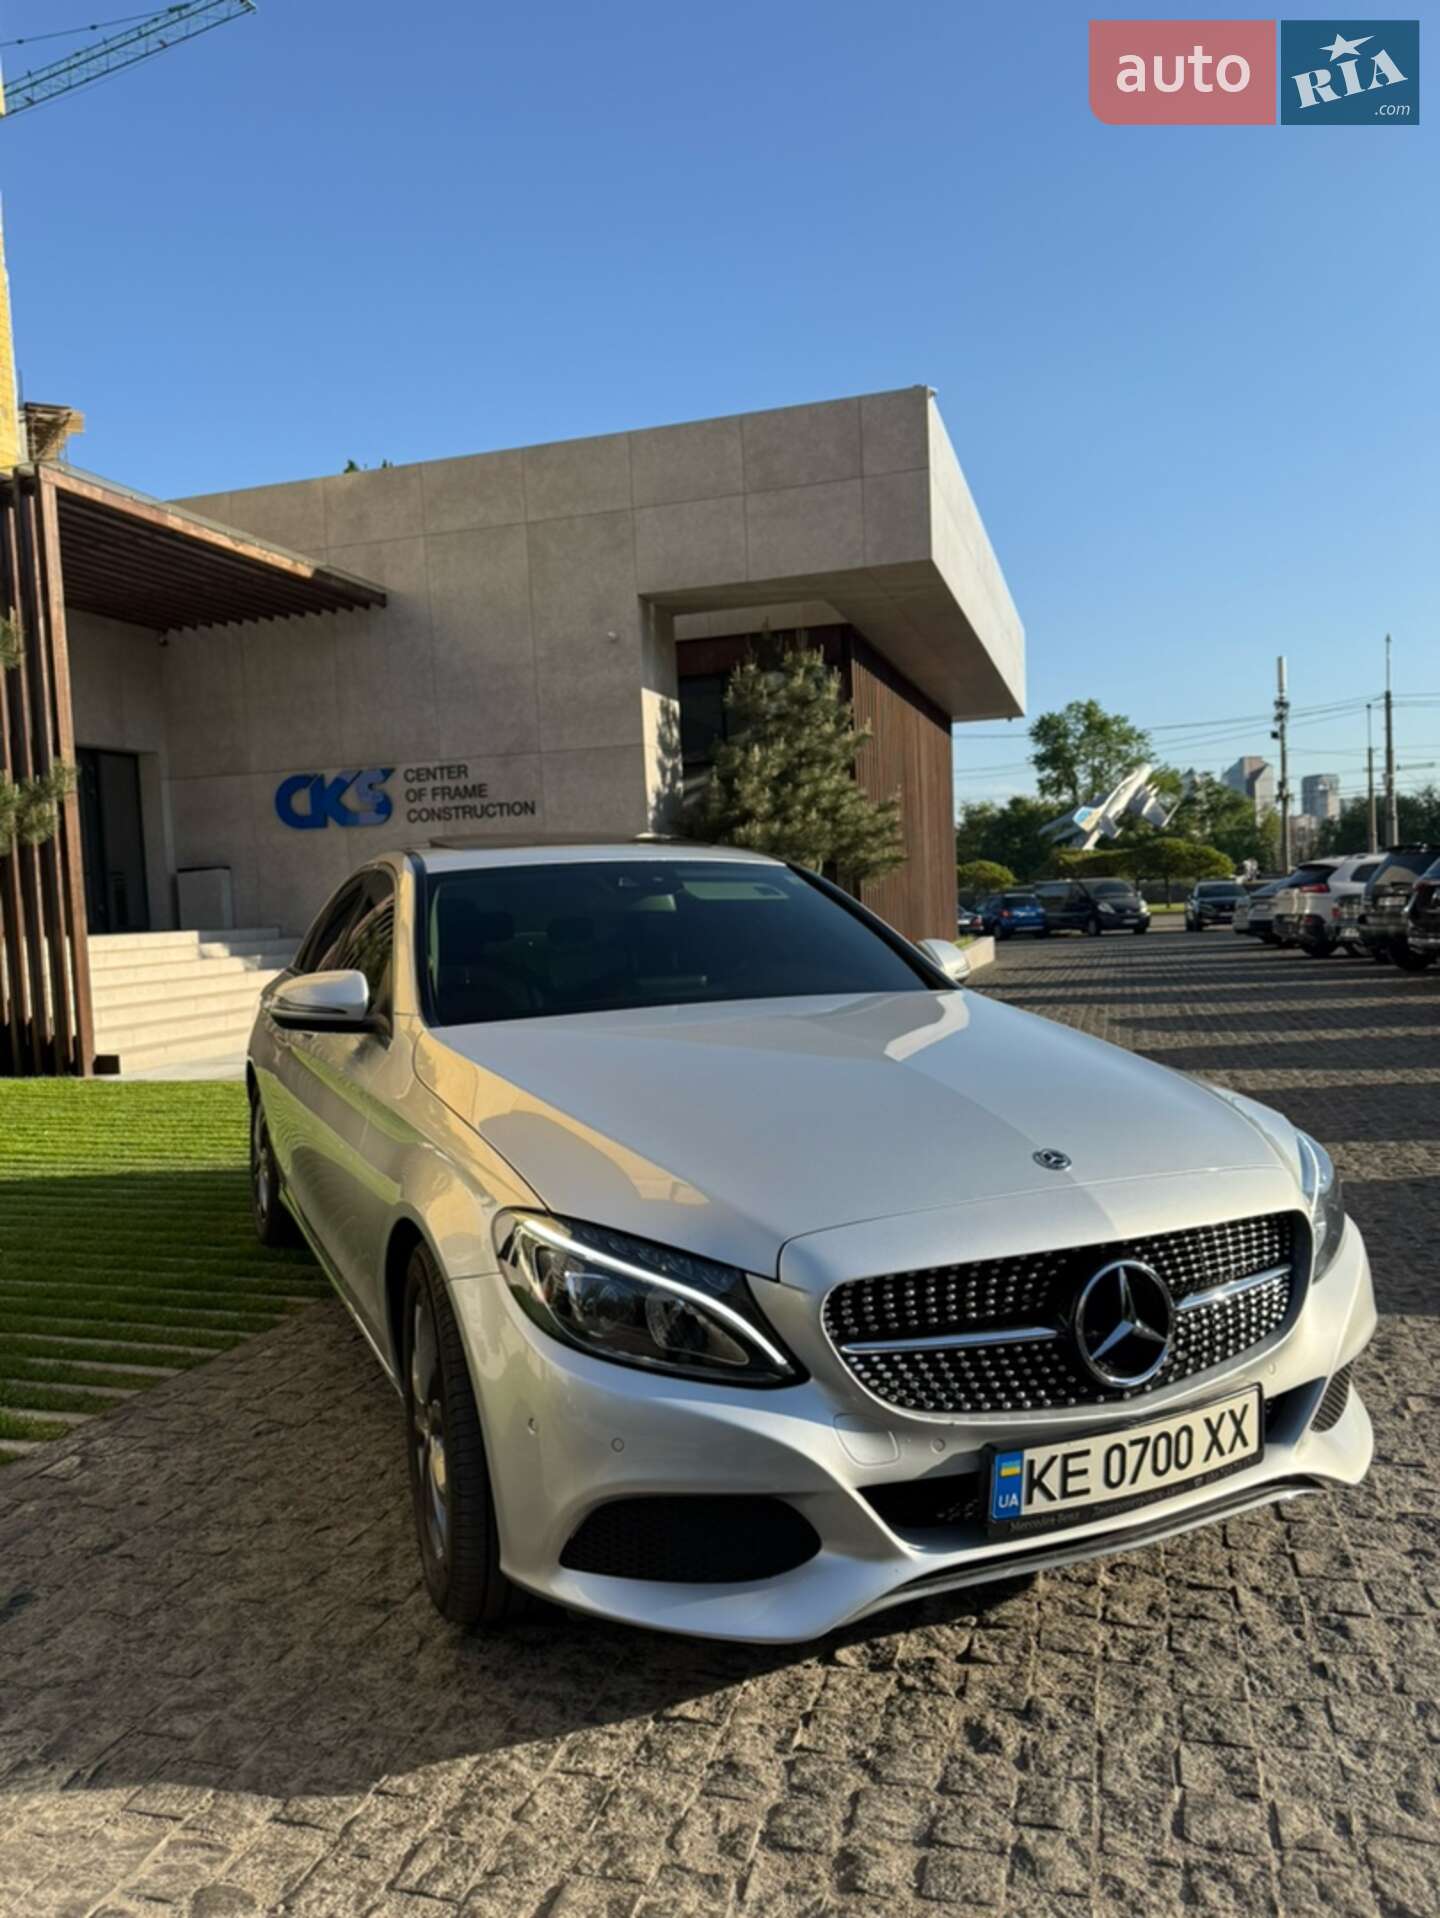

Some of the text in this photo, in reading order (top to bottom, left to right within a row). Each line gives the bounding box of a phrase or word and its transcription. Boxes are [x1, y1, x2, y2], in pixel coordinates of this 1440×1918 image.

[403, 764, 468, 783] CENTER
[275, 767, 396, 830] CKS
[405, 783, 488, 803] OF FRAME
[407, 801, 536, 823] CONSTRUCTION
[1025, 1449, 1092, 1506] KE
[1103, 1424, 1194, 1490] 0700
[1202, 1404, 1249, 1463] XX
[998, 1494, 1019, 1509] UA
